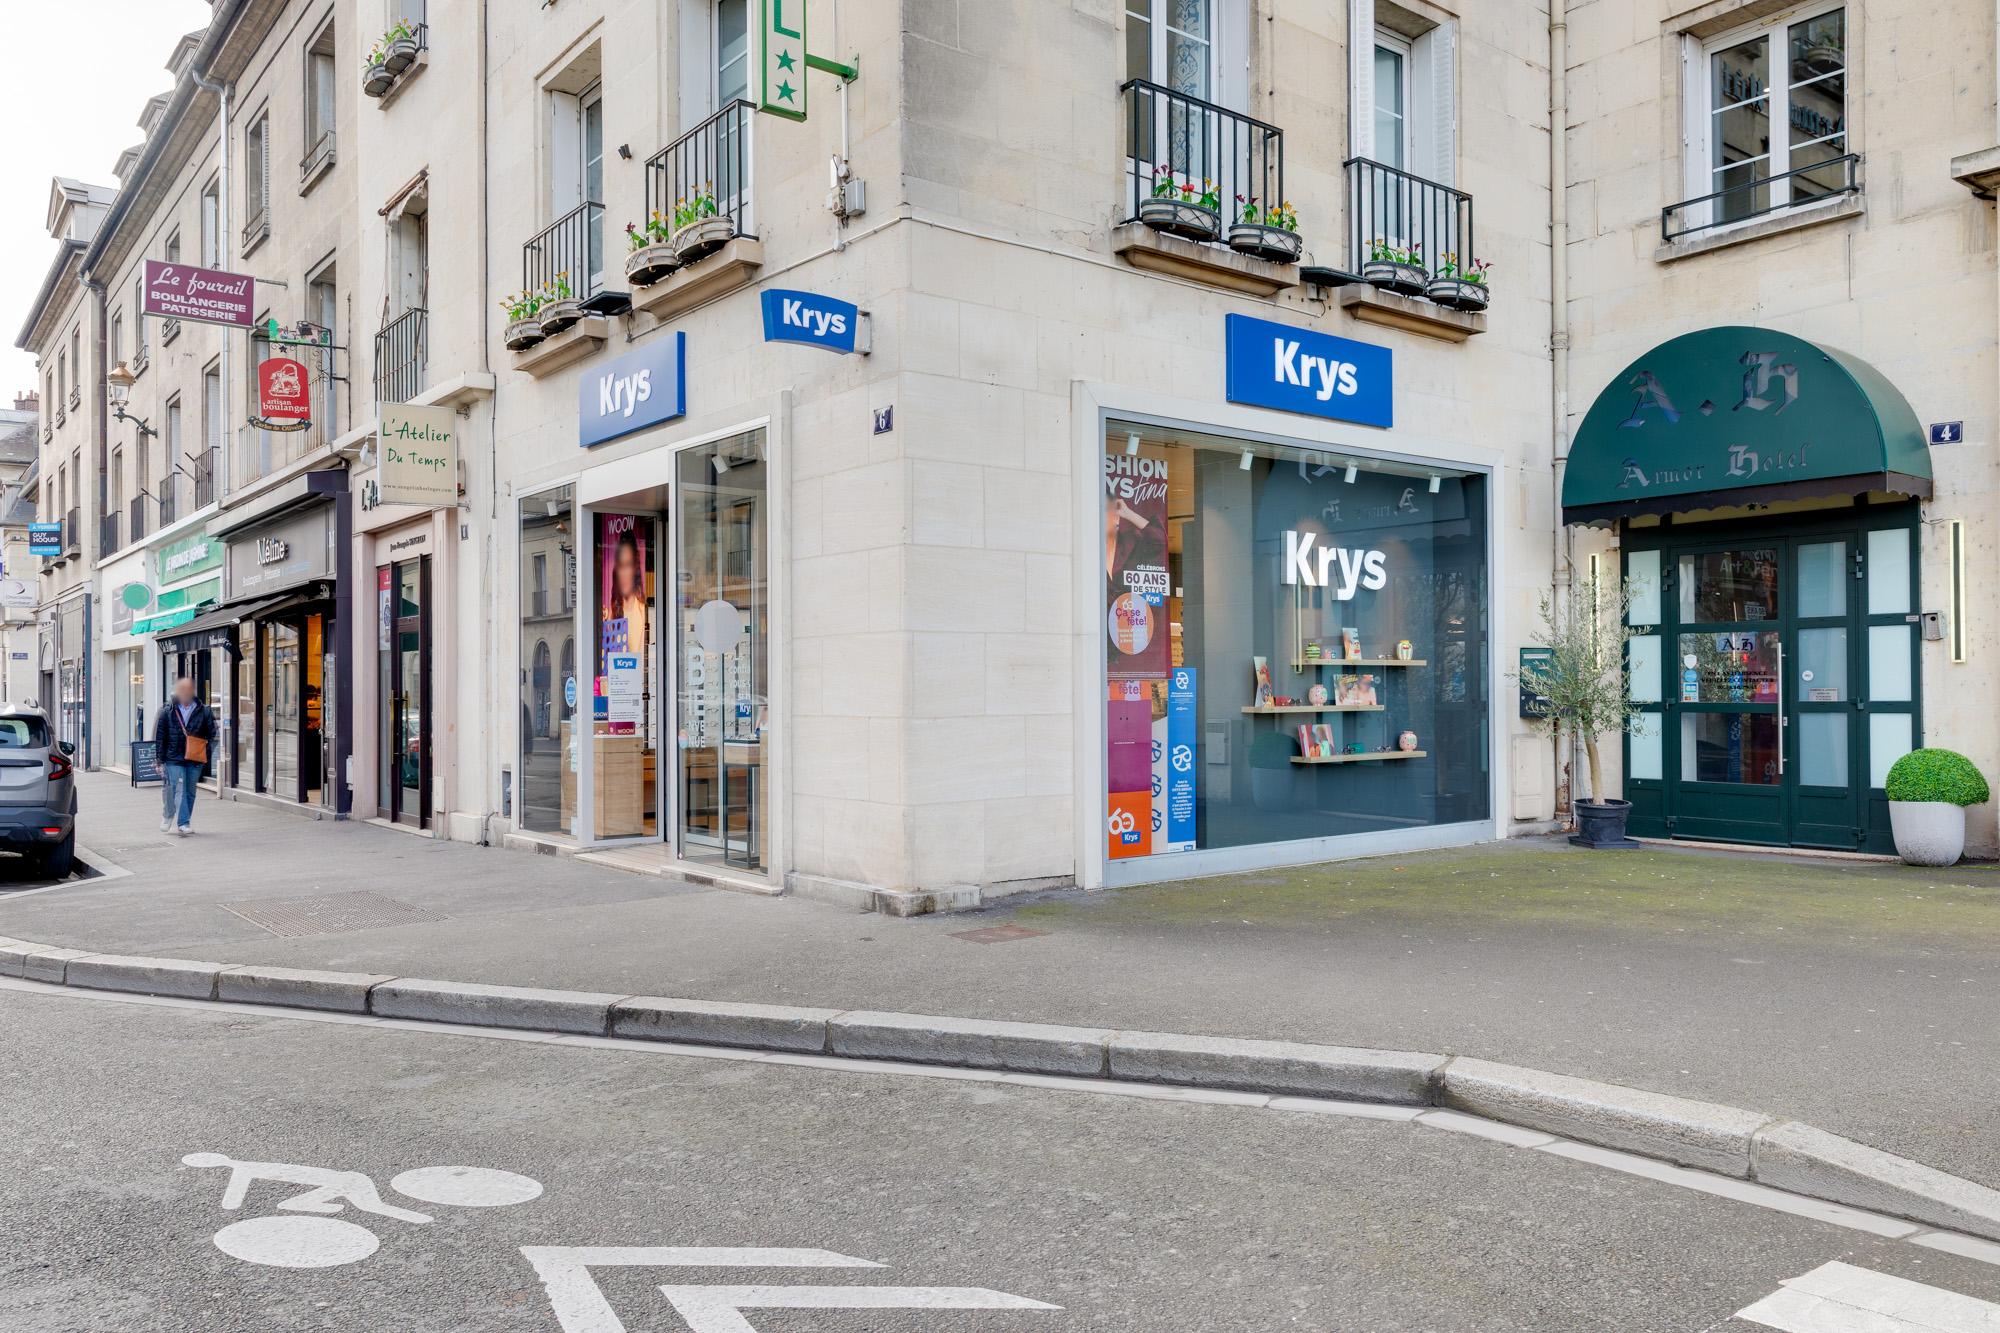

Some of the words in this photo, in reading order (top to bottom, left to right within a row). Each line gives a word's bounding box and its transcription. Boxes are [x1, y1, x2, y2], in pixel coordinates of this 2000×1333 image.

[152, 267, 180, 286] Le
[186, 272, 247, 296] fournil
[151, 291, 246, 312] BOULANGERIE
[161, 303, 237, 321] PATISSERIE
[782, 297, 847, 337] Krys
[1274, 337, 1358, 401] Krys
[600, 367, 652, 418] Krys
[262, 402, 309, 413] boulanger
[879, 409, 886, 430] 6
[382, 418, 451, 443] L'Atelier
[1940, 423, 1953, 442] 4
[387, 448, 403, 463] Du
[408, 451, 446, 473] Temps
[1615, 457, 1705, 489] Armor
[1724, 441, 1813, 480] Hotel
[608, 515, 635, 534] WOOW
[256, 537, 285, 565] Méline
[1284, 530, 1387, 601] Krys
[1125, 572, 1140, 585] 60
[1143, 573, 1167, 585] ANS
[1133, 585, 1143, 593] DE
[1145, 586, 1167, 594] STYLE
[1146, 594, 1160, 604] Krys
[1115, 608, 1128, 620] Ça
[1131, 609, 1141, 617] se
[616, 659, 634, 668] Krys
[1108, 807, 1135, 836] 60
[1124, 833, 1139, 842] Krys
